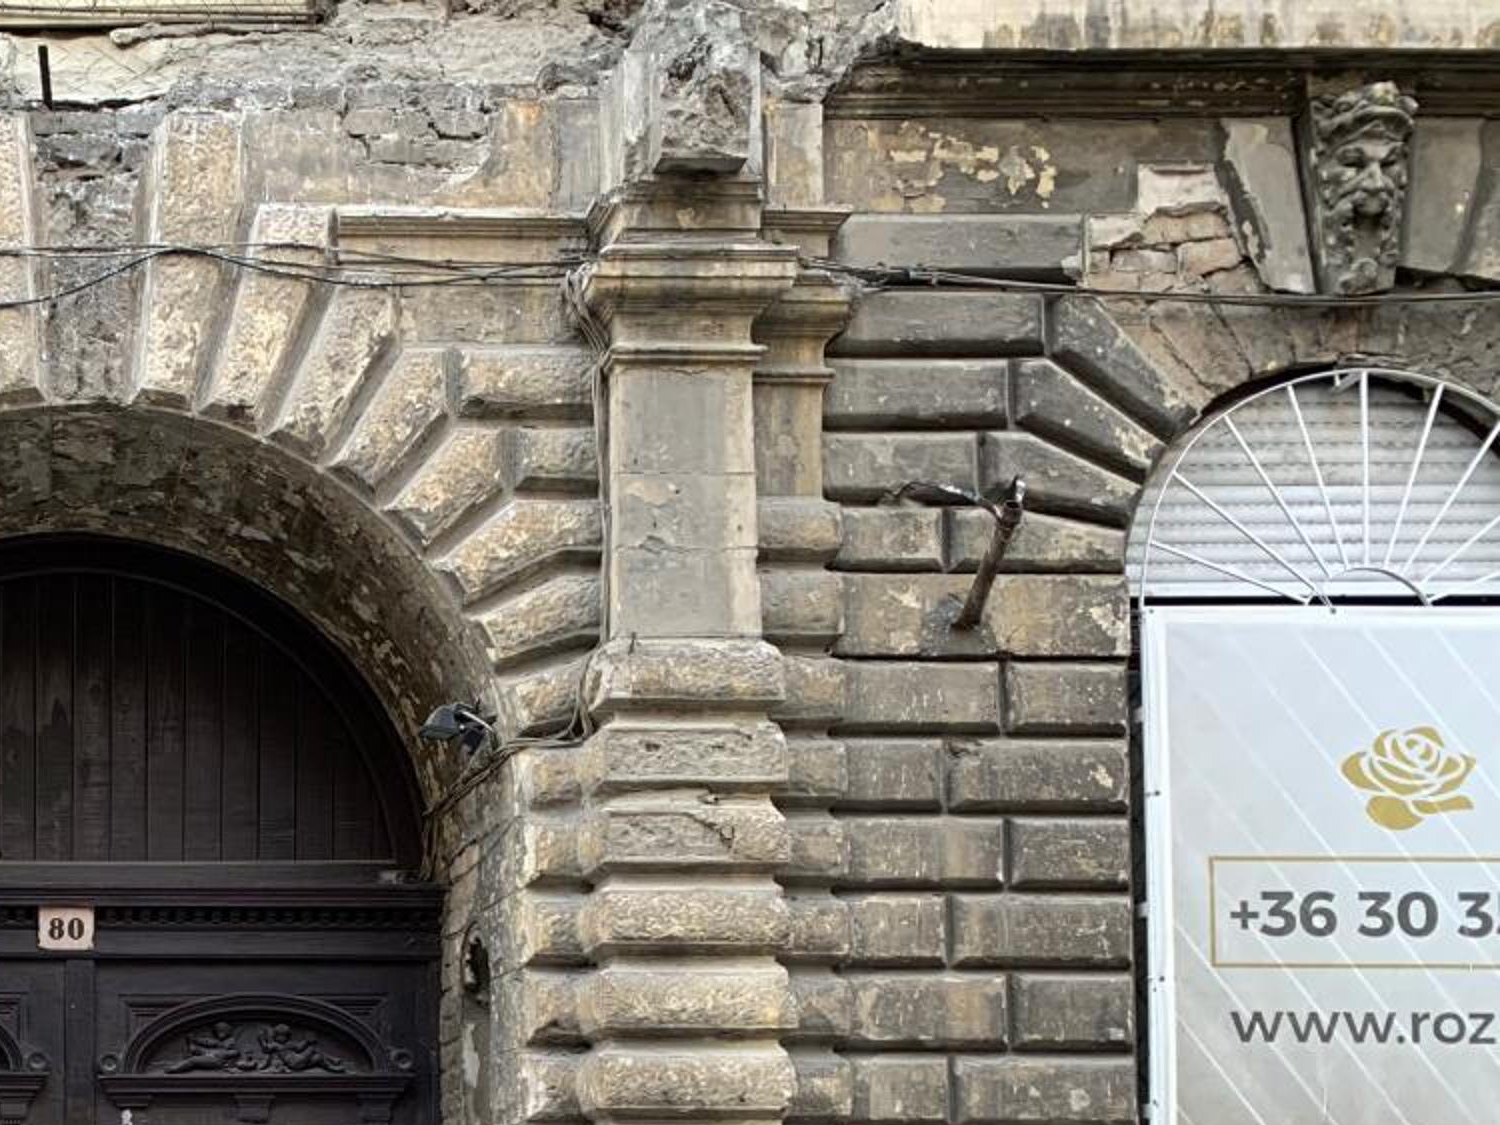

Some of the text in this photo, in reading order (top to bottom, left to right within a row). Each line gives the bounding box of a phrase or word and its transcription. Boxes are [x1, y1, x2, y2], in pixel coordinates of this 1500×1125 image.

[48, 917, 85, 940] 80
[1230, 891, 1500, 938] +36 30 3
[1230, 1011, 1497, 1044] www.roz
